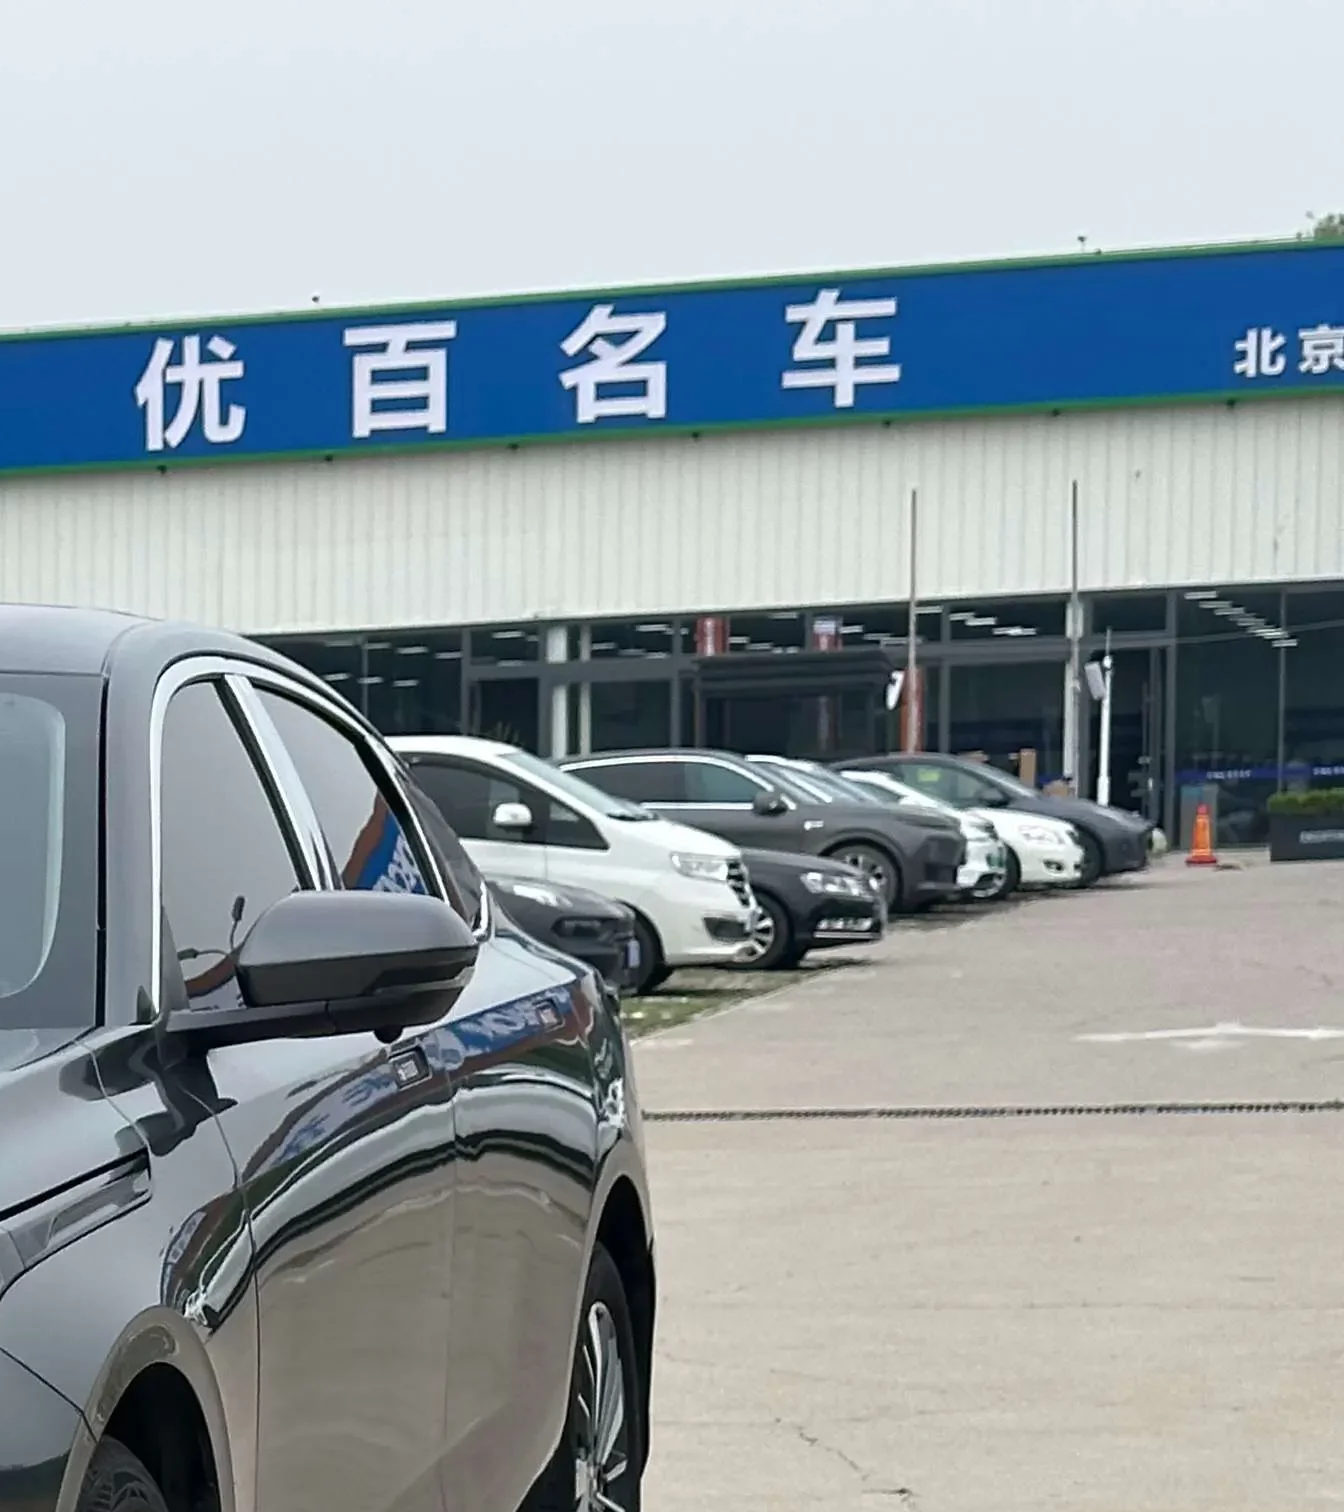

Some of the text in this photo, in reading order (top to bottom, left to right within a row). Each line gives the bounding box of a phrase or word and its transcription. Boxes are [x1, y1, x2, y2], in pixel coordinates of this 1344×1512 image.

[135, 289, 902, 452] 优百名车
[1234, 324, 1344, 378] 北京
